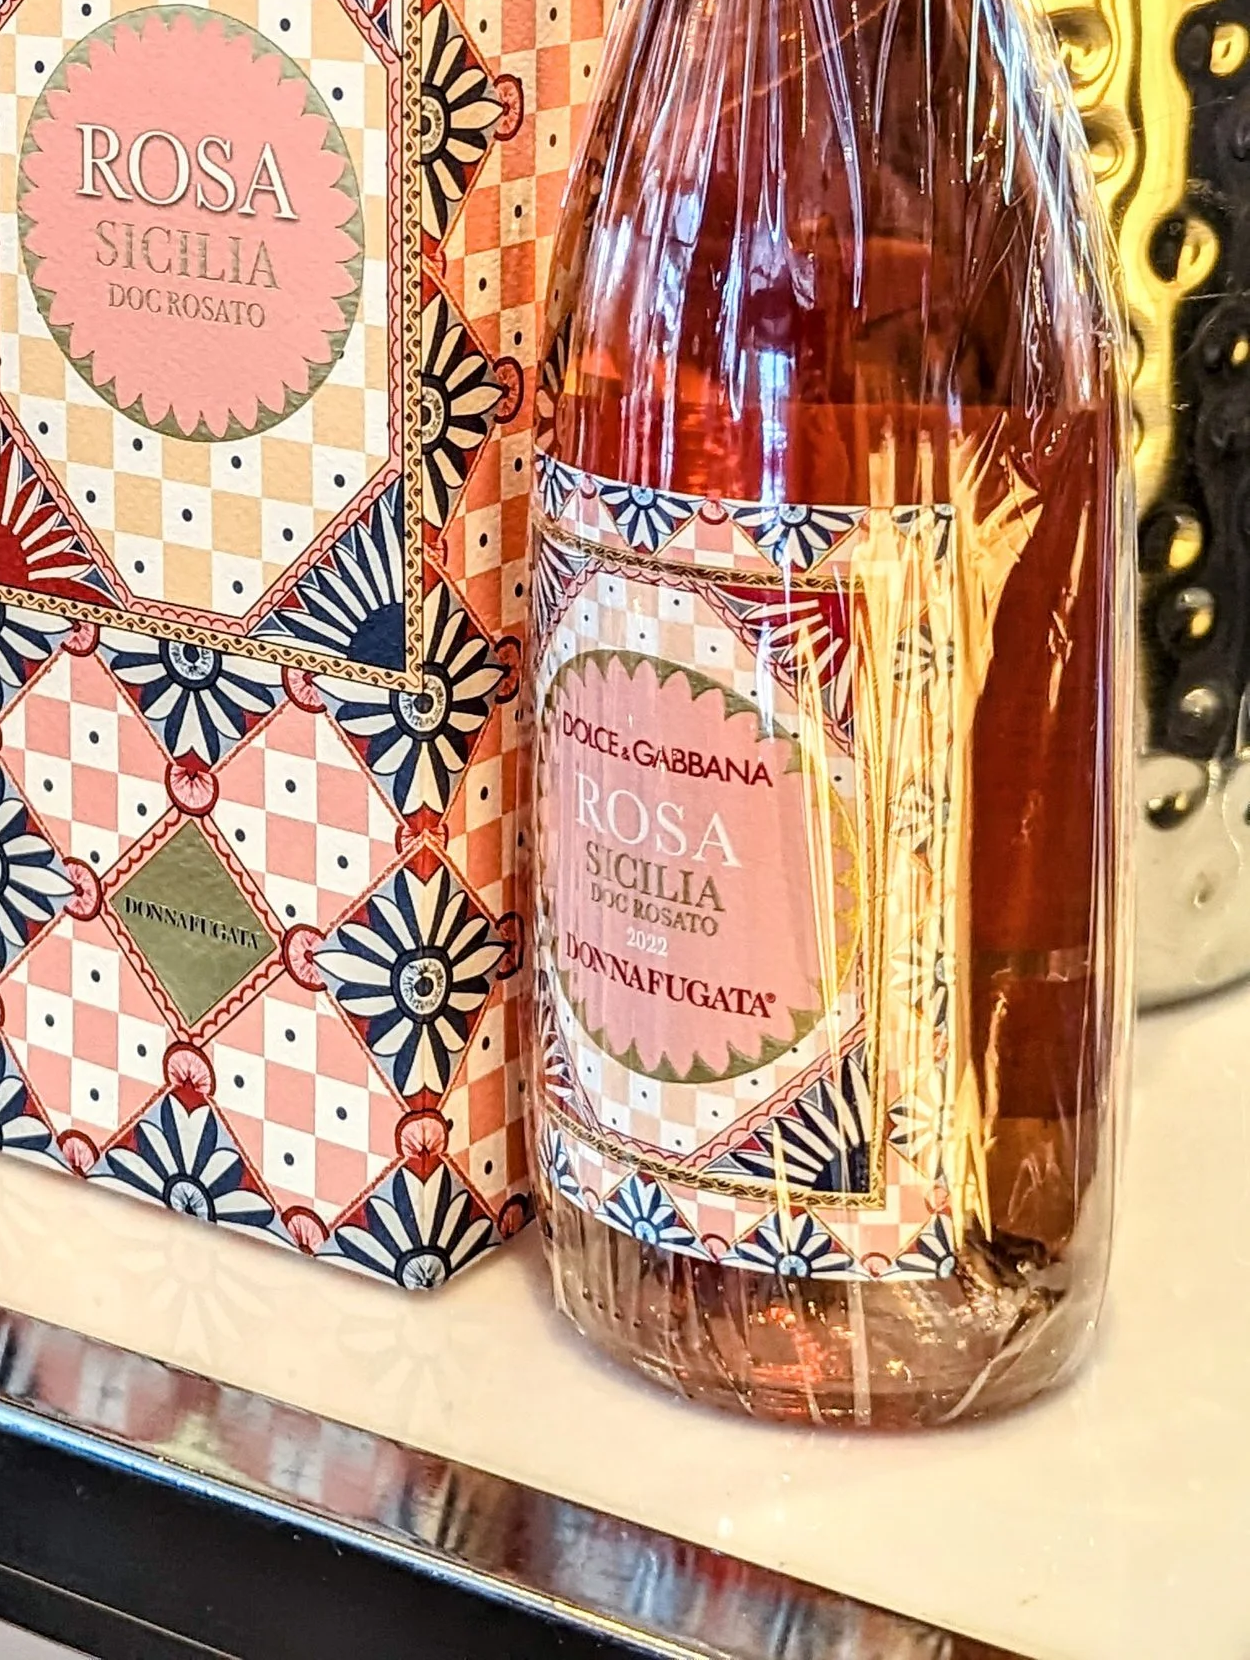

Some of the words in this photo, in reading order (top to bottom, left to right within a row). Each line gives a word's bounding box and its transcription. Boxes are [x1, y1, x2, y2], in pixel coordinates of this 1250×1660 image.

[75, 123, 300, 221] ROSA
[95, 219, 282, 290] SICILIA
[108, 283, 162, 313] DOC
[167, 291, 267, 329] ROSATO
[575, 771, 743, 869] ROSA
[586, 840, 726, 913] SICILIA
[125, 896, 259, 950] DONNAFUGATA
[590, 882, 629, 914] DOC
[633, 898, 719, 938] ROSATO
[625, 926, 670, 958] 2022
